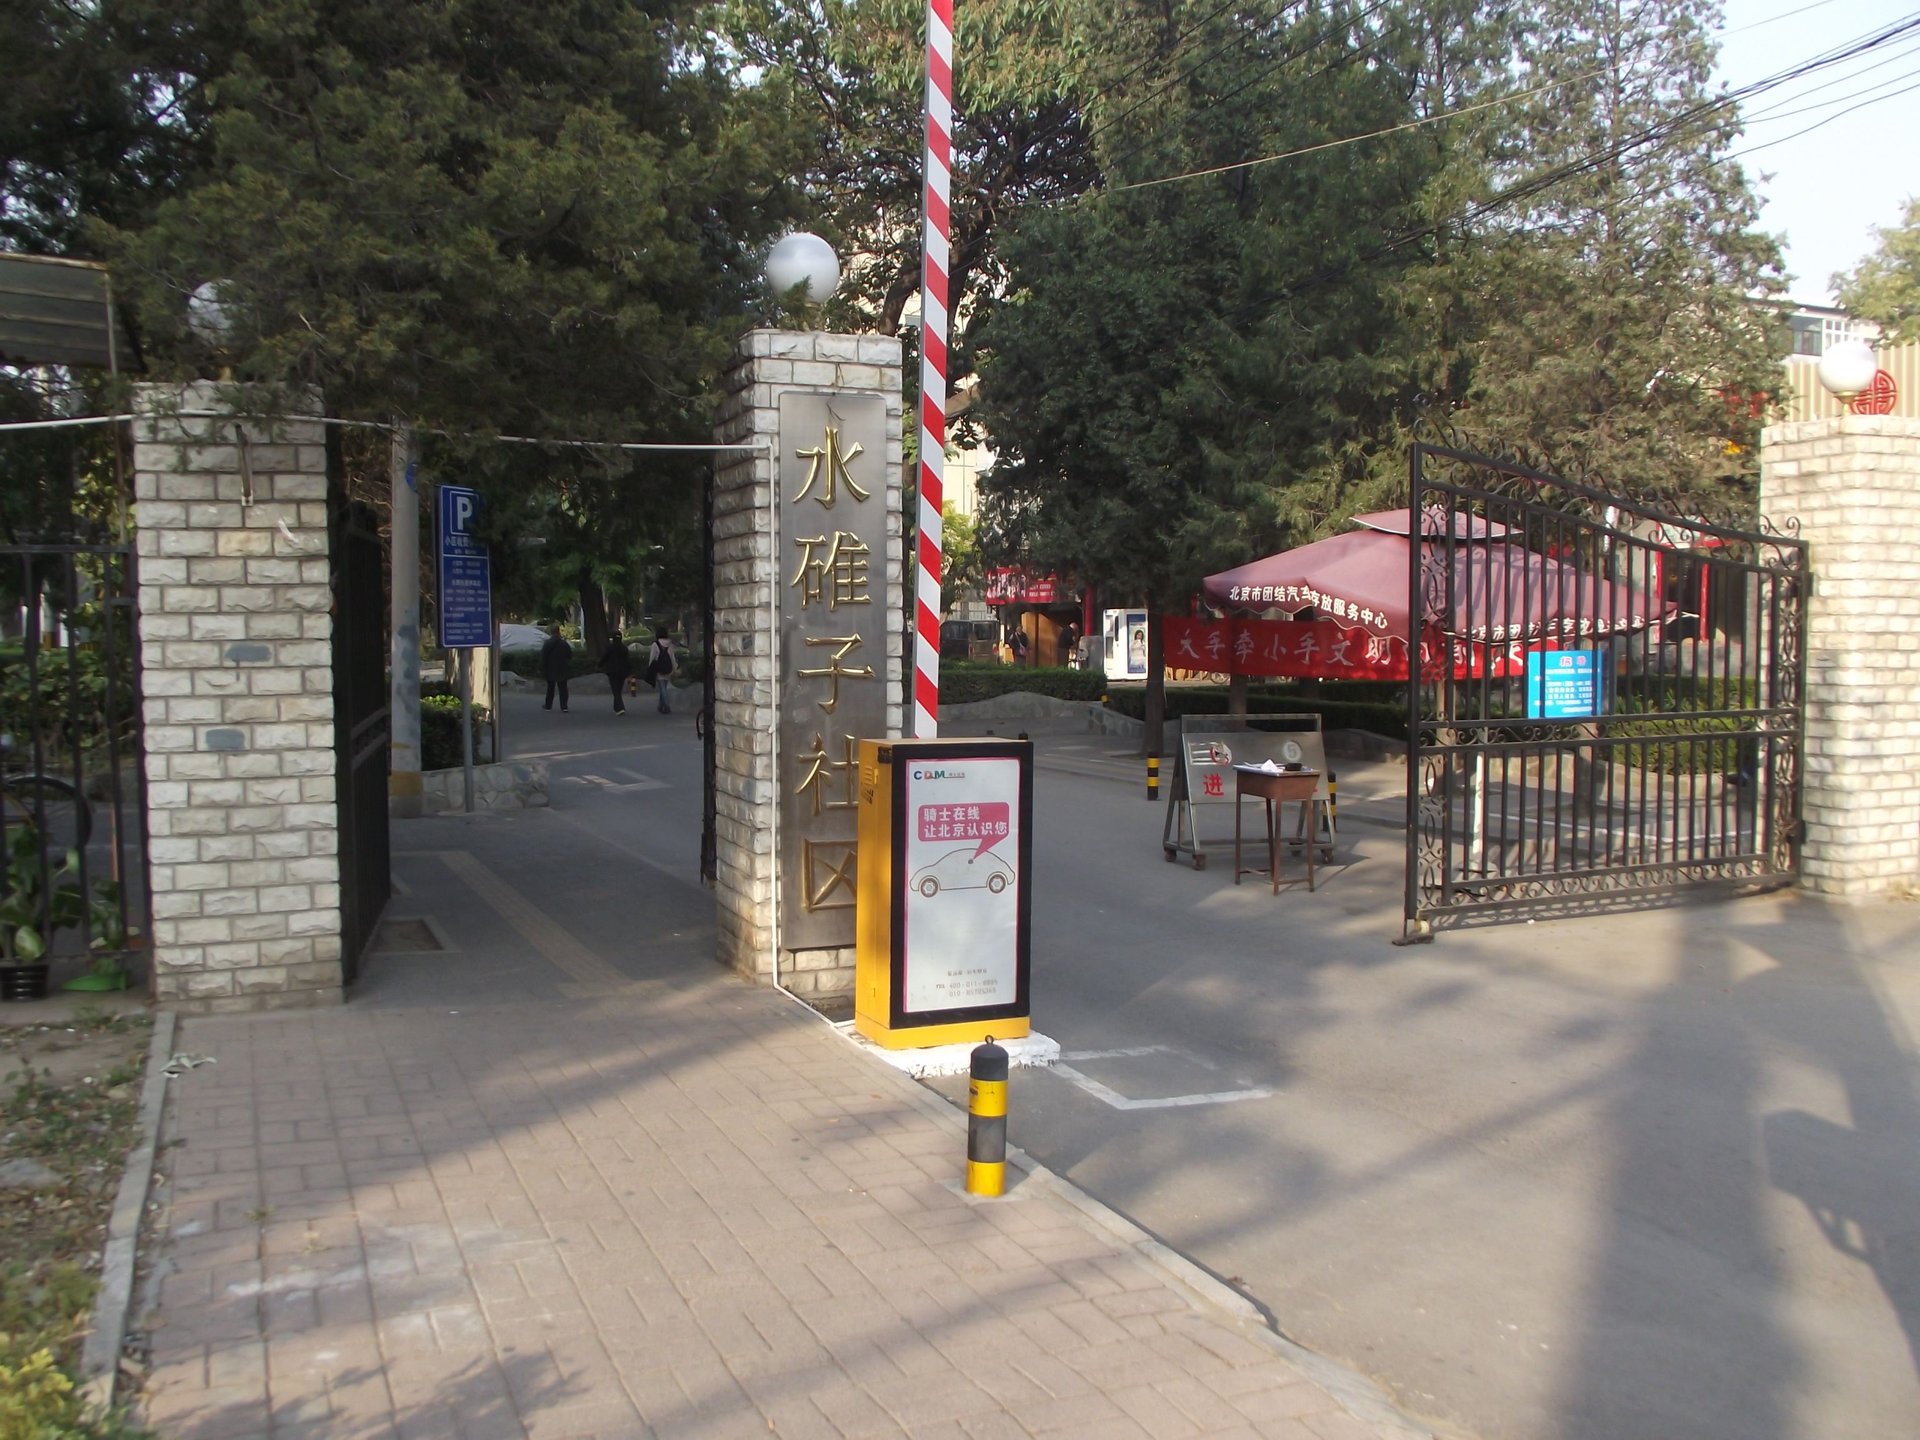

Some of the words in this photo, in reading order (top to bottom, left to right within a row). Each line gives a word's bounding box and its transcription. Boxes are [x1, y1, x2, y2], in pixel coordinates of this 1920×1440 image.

[456, 496, 473, 530] P
[1203, 773, 1225, 796] 进
[923, 806, 980, 822] 骑士在线
[924, 821, 1008, 838] 让北京认识您
